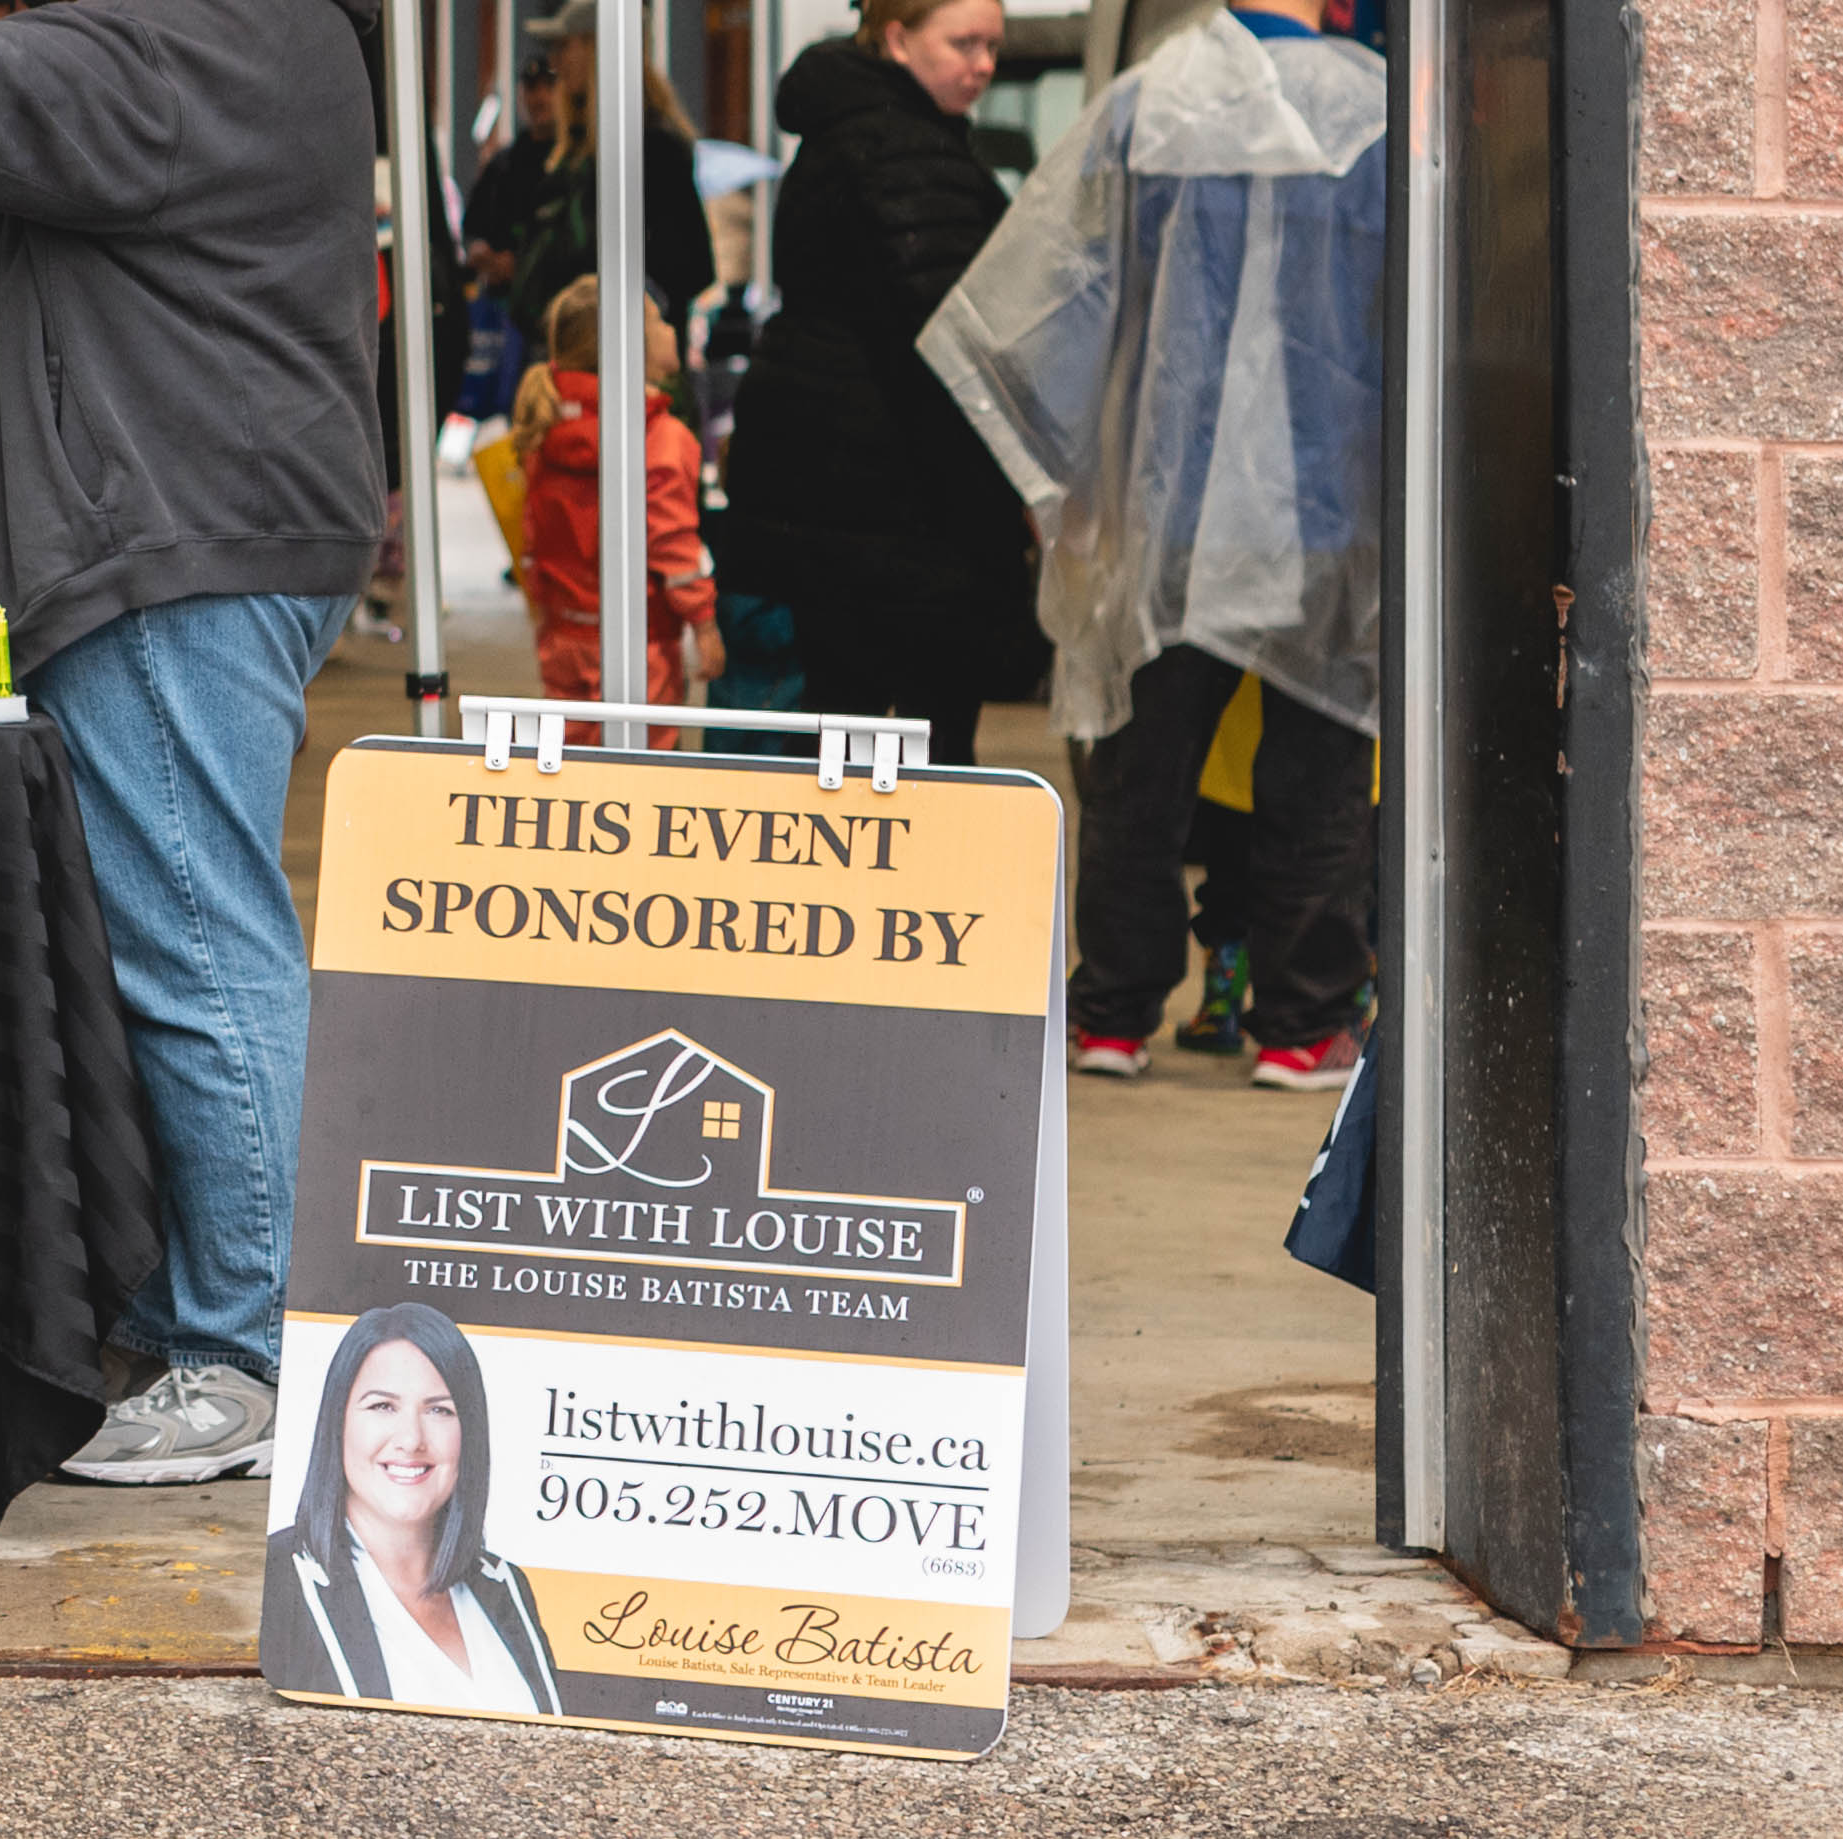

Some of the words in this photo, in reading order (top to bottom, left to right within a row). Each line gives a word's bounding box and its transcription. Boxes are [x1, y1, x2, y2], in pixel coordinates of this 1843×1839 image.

[449, 793, 631, 855] THIS
[649, 804, 910, 871] EVENT
[382, 877, 855, 959] SPONSORED
[873, 907, 984, 966] BY
[398, 1185, 520, 1232] LIST
[535, 1195, 691, 1246] WITH
[710, 1208, 923, 1262] LOUISE
[404, 1259, 478, 1289] THE
[491, 1266, 626, 1301] LOUISE
[641, 1277, 792, 1313] BATISTA
[805, 1289, 911, 1322] TEAM
[543, 1387, 990, 1472] listwithlouise.ca
[536, 1473, 987, 1552] 905.252.MOVE
[921, 1555, 986, 1580] (6683)
[583, 1590, 764, 1656] Louise
[775, 1603, 982, 1675] Batista
[638, 1654, 678, 1669] Louise
[682, 1658, 726, 1674] Batista,
[730, 1663, 755, 1675] Sale
[758, 1665, 849, 1685] Representative
[852, 1674, 862, 1685] &
[865, 1673, 899, 1689] Team
[903, 1676, 947, 1693] Leader
[767, 1693, 821, 1709] CENTURY
[821, 1698, 834, 1709] 21
